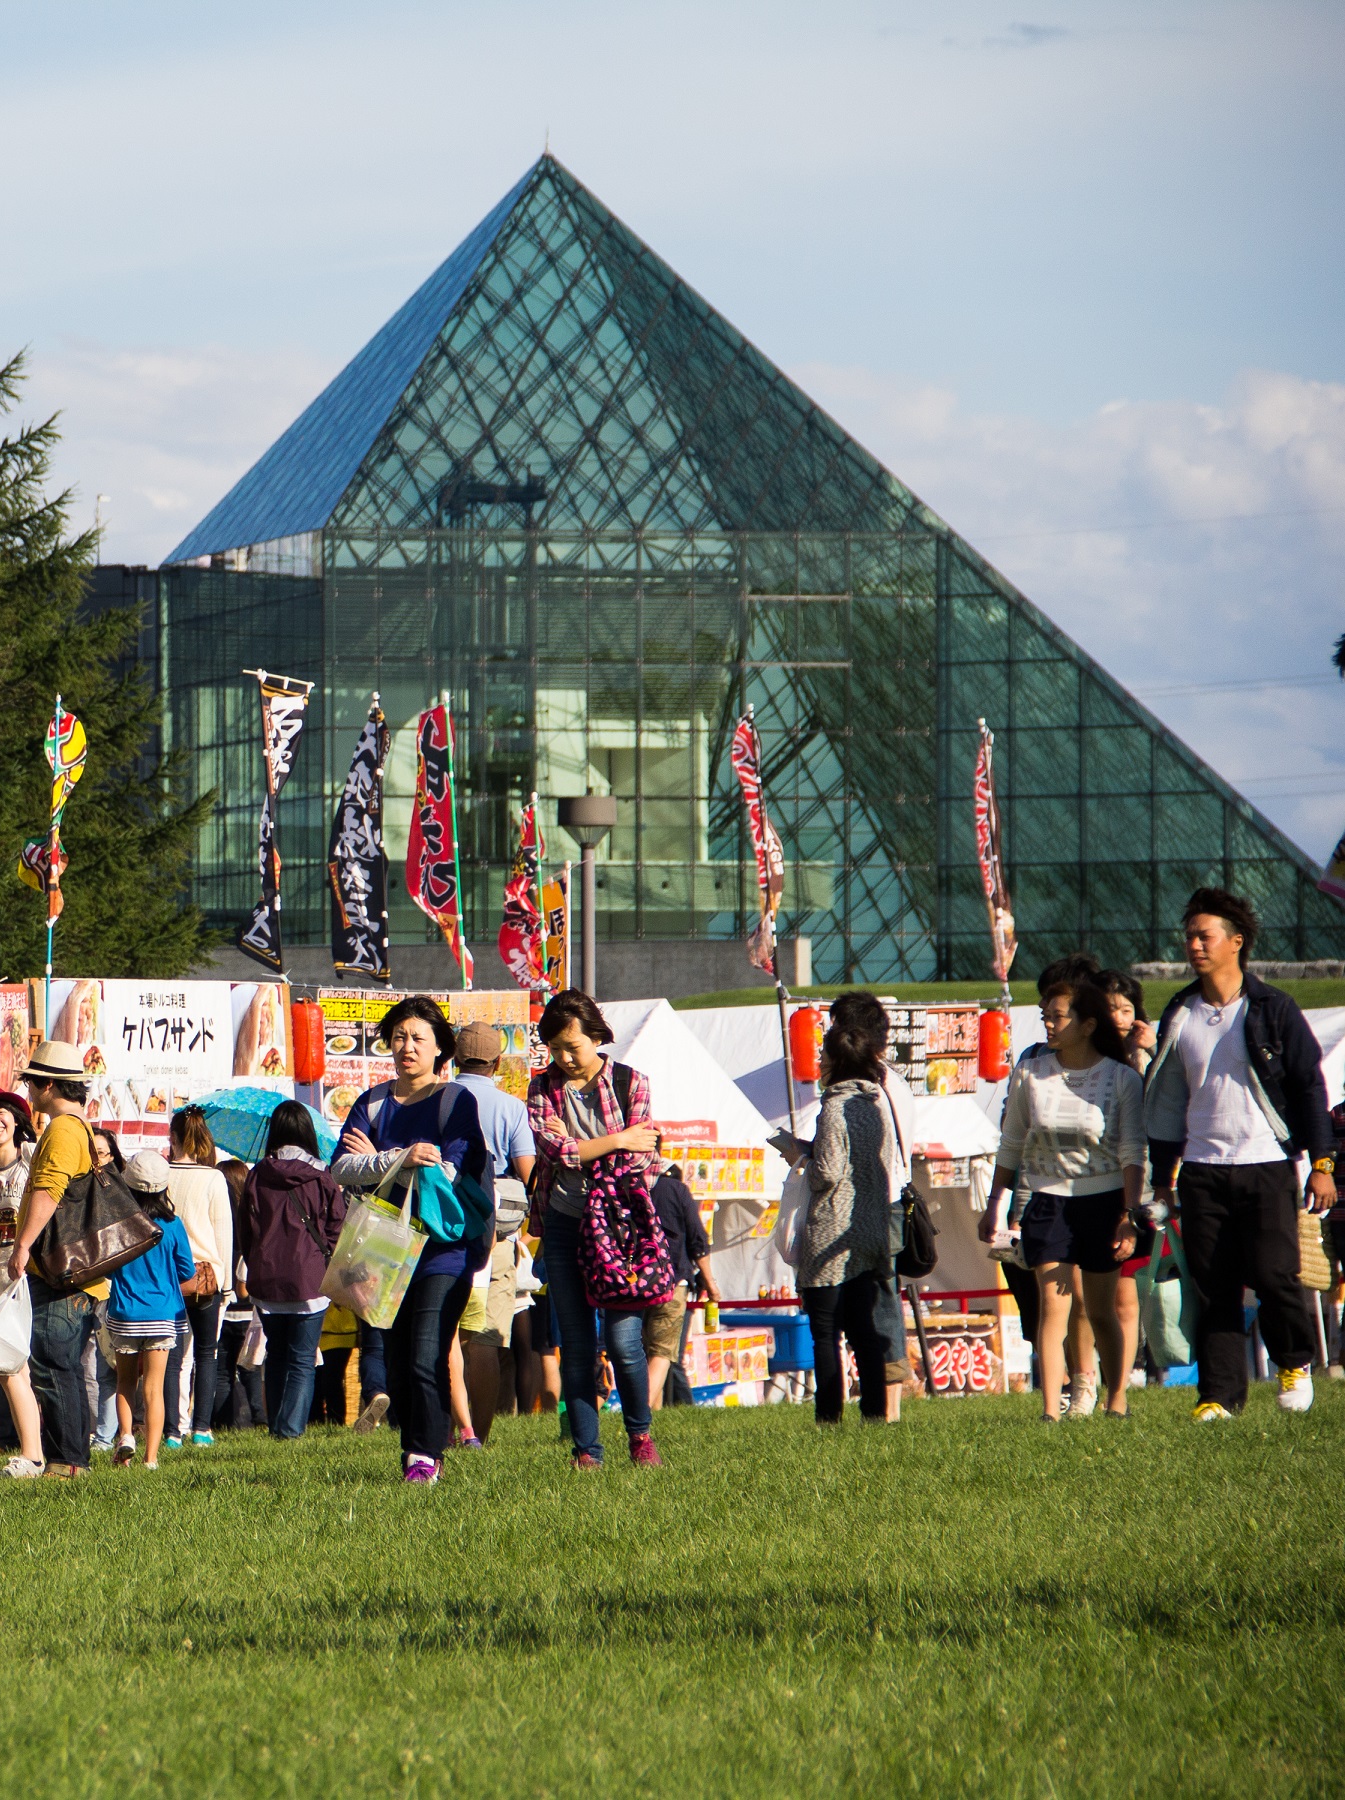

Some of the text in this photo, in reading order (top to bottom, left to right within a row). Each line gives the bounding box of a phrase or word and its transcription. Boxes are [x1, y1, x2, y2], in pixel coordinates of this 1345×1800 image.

[122, 1017, 214, 1052] ケバブサンド
